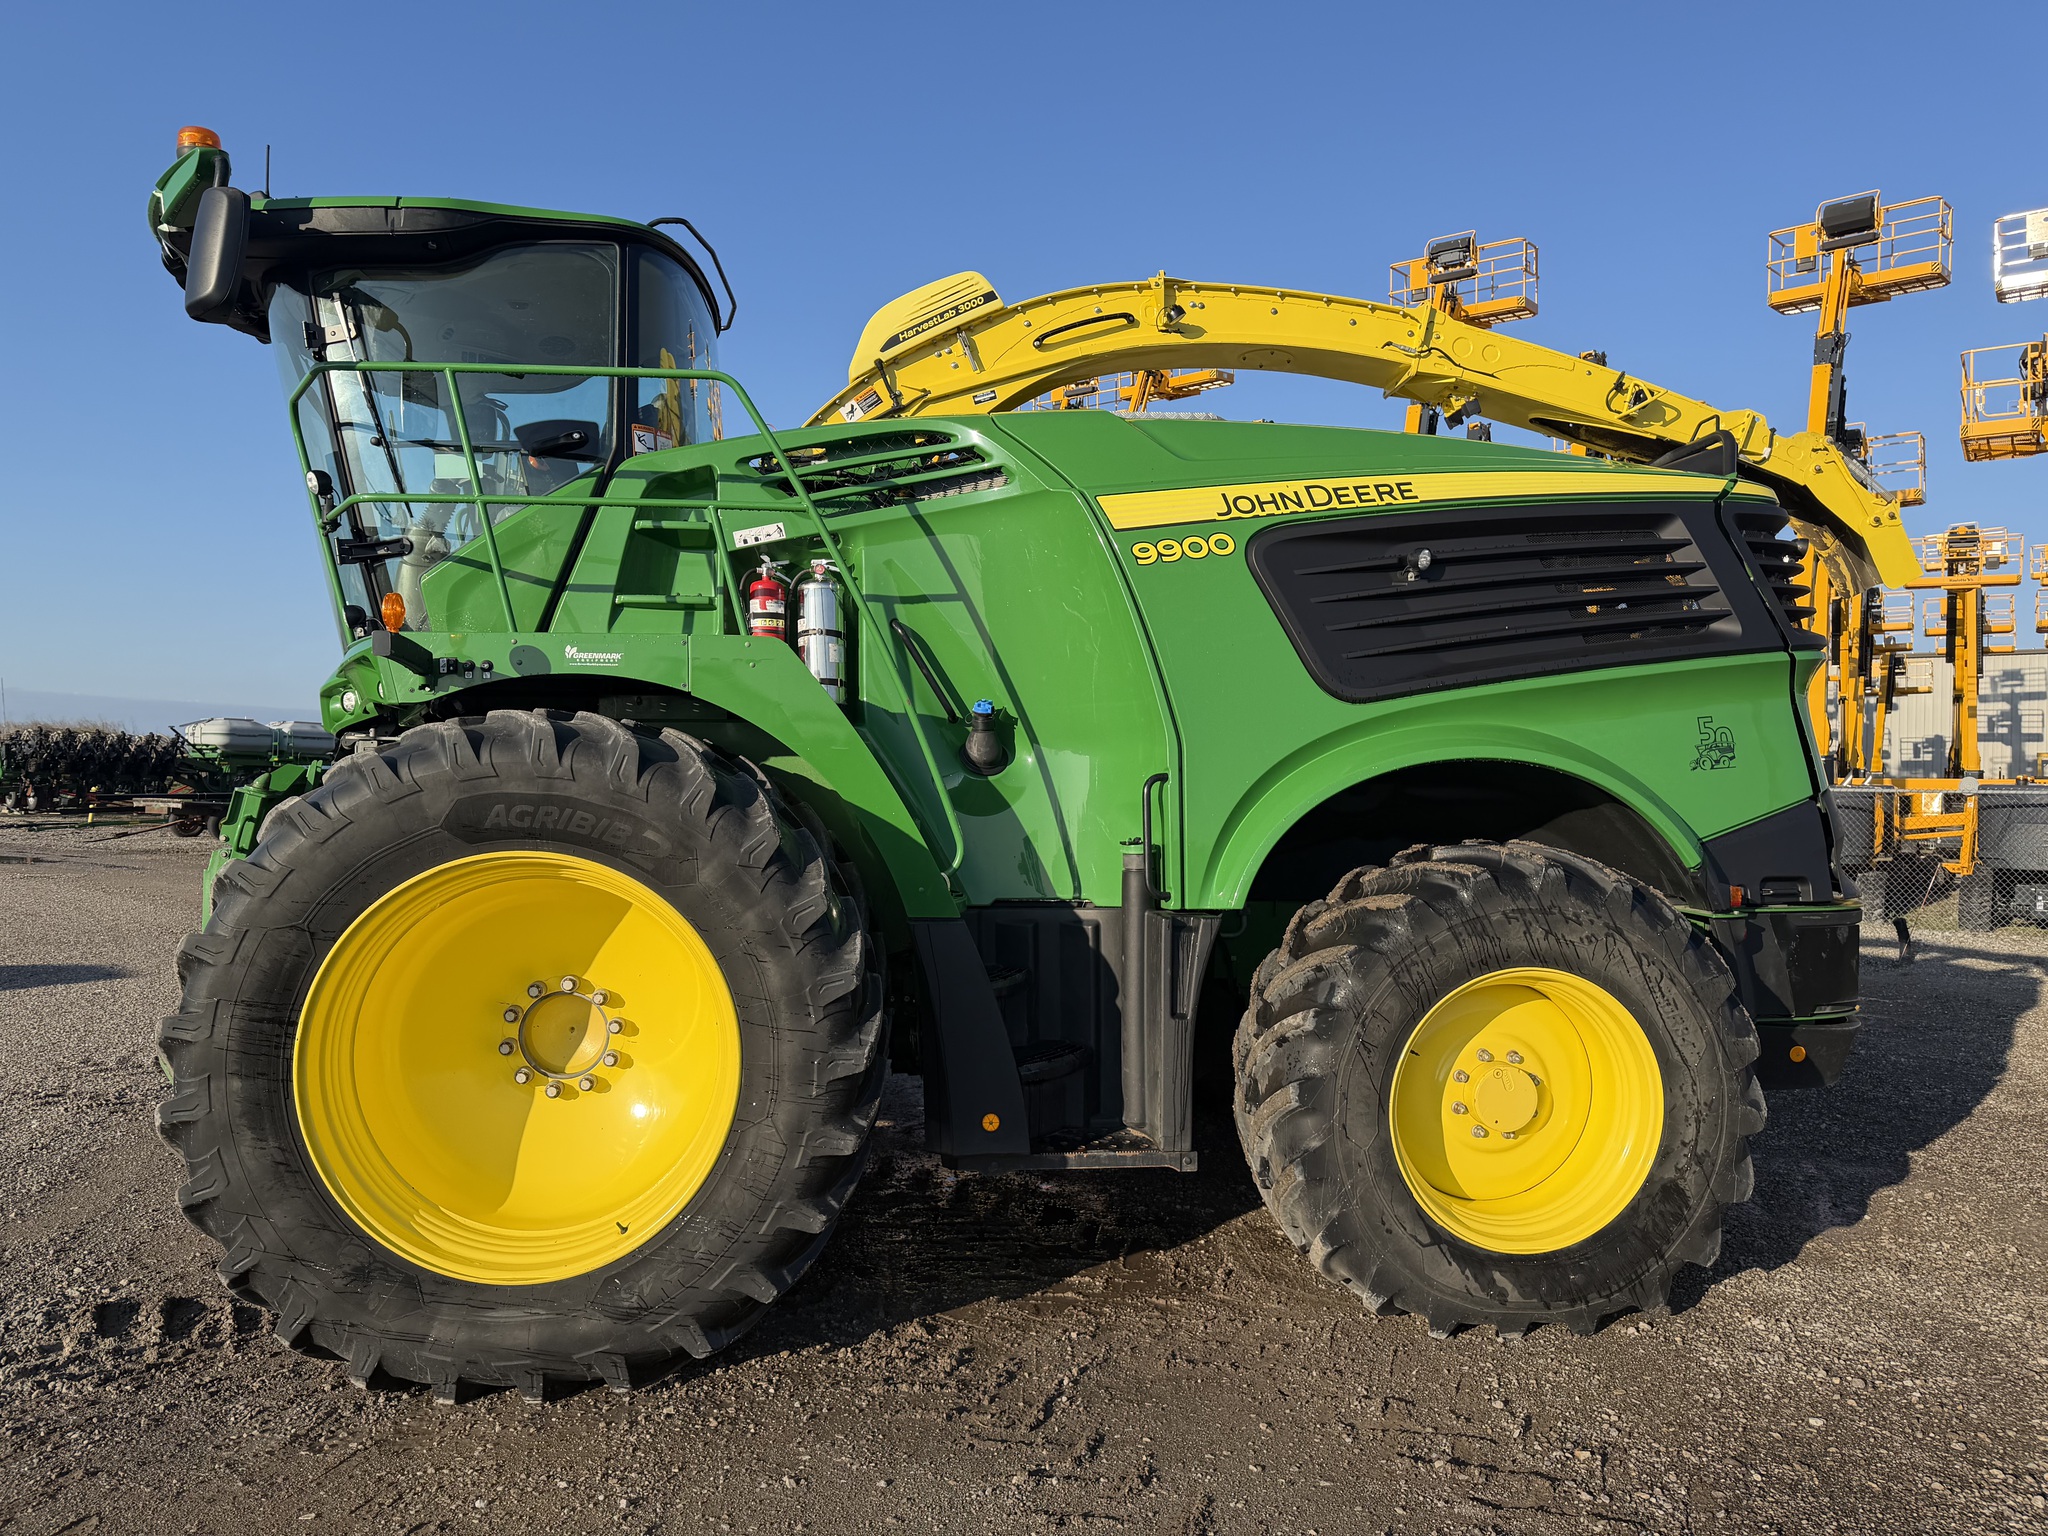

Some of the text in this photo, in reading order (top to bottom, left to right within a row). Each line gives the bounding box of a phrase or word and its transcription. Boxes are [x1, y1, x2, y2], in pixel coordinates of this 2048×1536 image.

[898, 296, 985, 341] HarvestLab 3000
[1216, 481, 1419, 517] JOHN DEERE
[1131, 532, 1236, 567] 9900
[573, 652, 622, 660] GREENMARK
[483, 804, 672, 870] AGRIBIB 2
